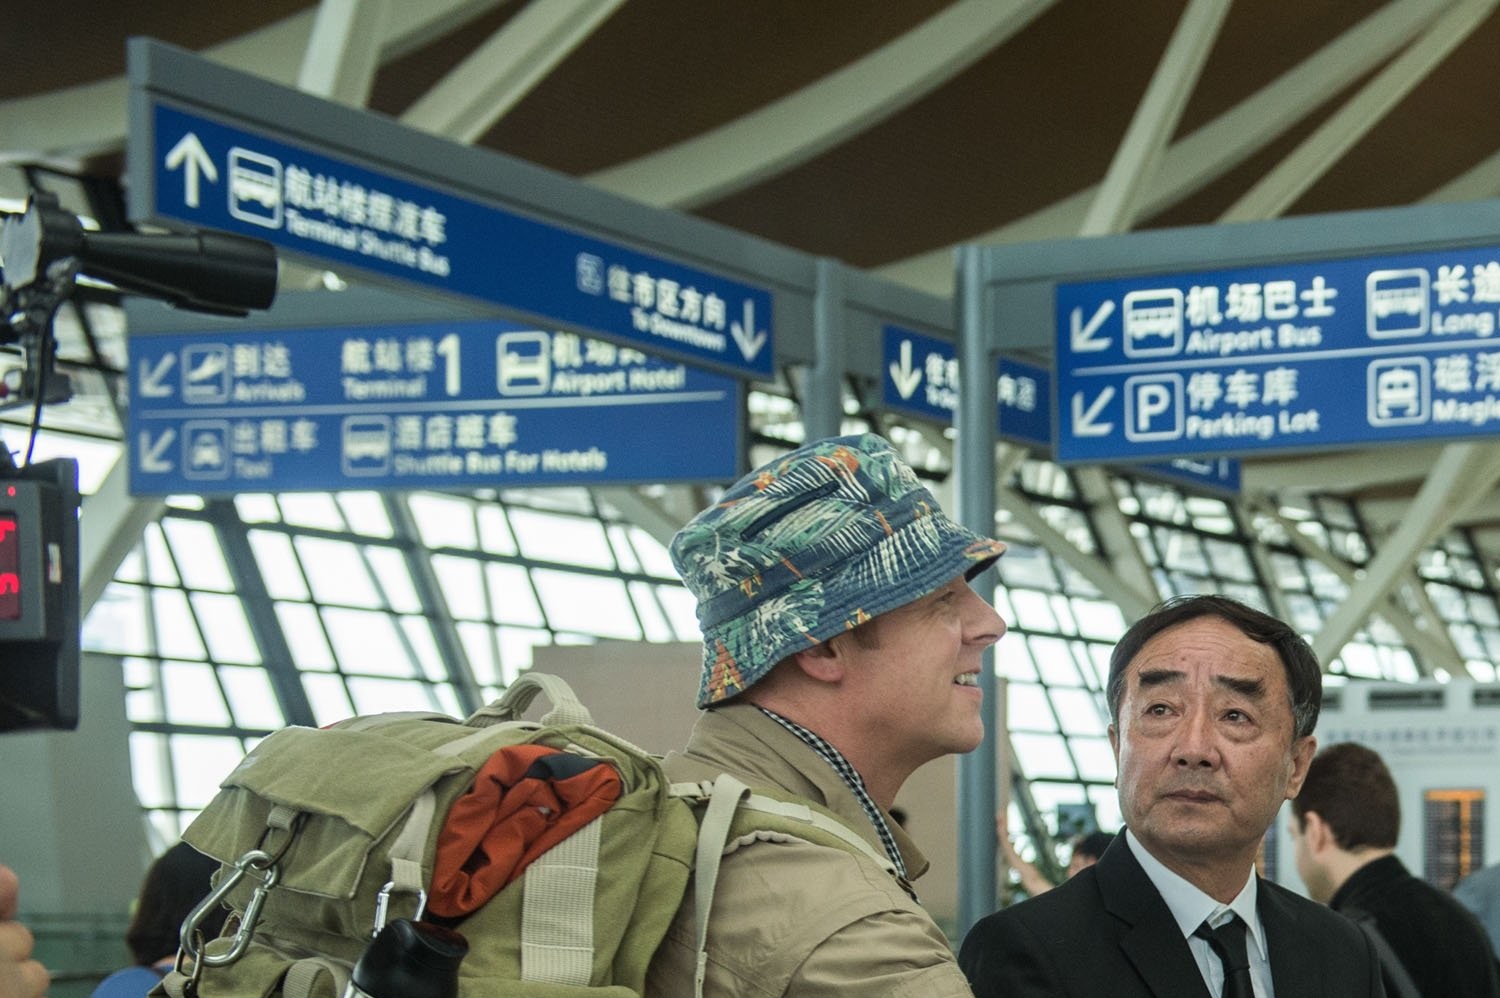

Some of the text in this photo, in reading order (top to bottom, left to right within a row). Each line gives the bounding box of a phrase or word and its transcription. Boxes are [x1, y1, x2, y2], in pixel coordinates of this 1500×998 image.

[286, 207, 450, 277] Terminal Shuttle Bus
[1185, 275, 1338, 326] 机场巴士
[631, 306, 726, 351] To Downtown
[1185, 323, 1322, 356] Airport Bus
[1431, 311, 1494, 337] Long
[233, 341, 291, 378] 到达
[342, 333, 461, 397] 航站楼 1
[234, 380, 306, 401] Arrivals
[343, 376, 427, 399] Terminal
[552, 364, 687, 397] Airport Hotel
[1186, 366, 1299, 411] 停车库
[233, 418, 318, 455] 出租车
[1186, 409, 1320, 440] Parking Lot
[234, 456, 272, 479] Taxi
[395, 446, 607, 475] Shuttle Bus For Hotels
